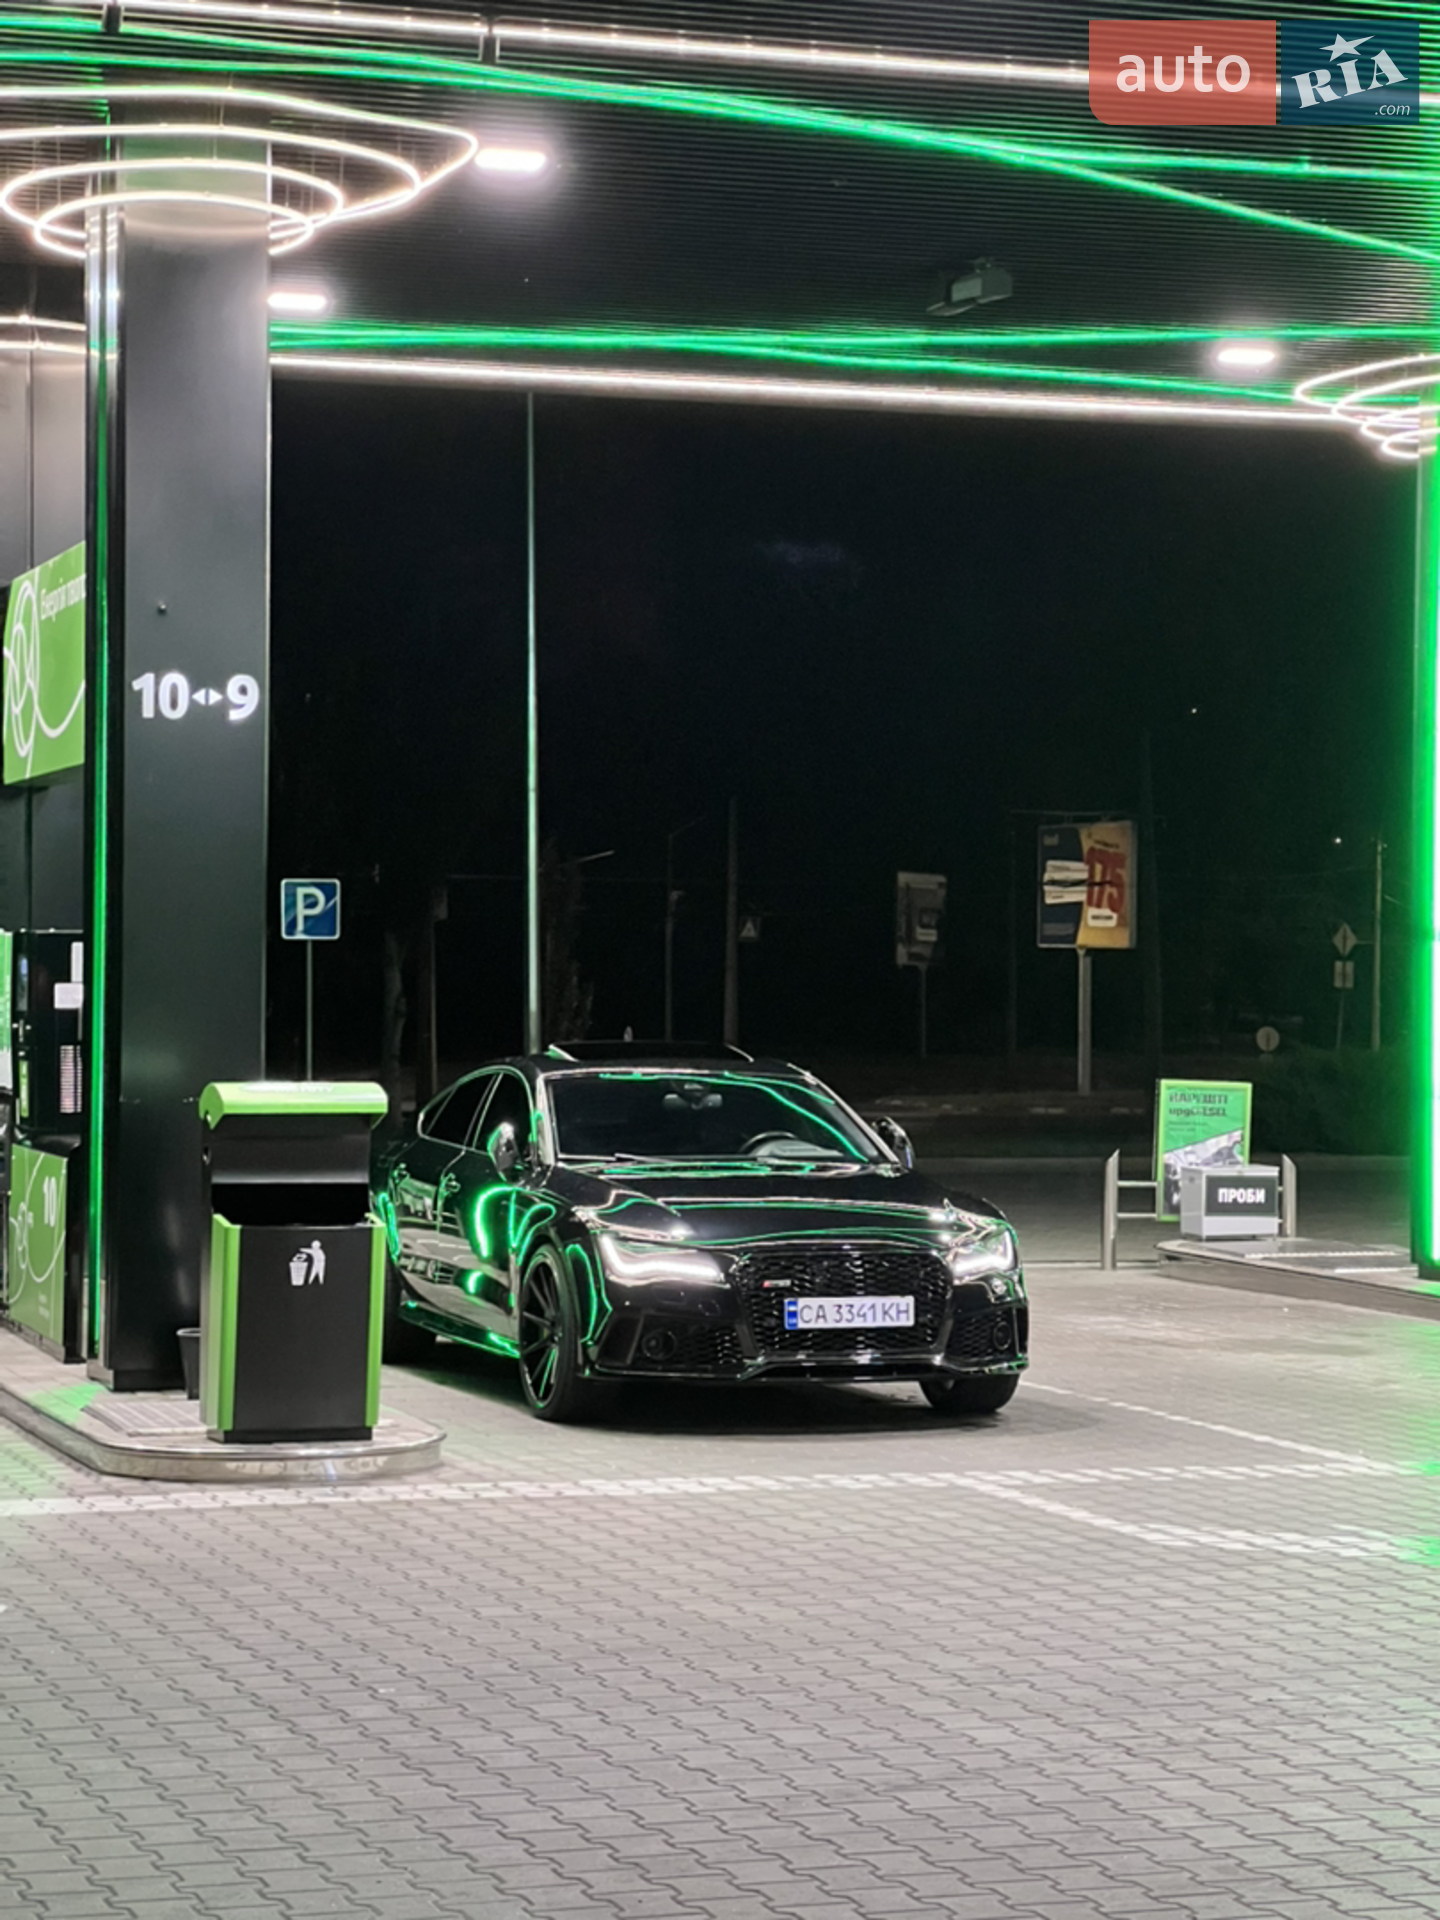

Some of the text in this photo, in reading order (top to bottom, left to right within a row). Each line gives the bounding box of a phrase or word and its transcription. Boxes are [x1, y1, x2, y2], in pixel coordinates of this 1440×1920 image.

[131, 672, 260, 722] 10 9
[295, 886, 326, 934] P
[42, 1176, 58, 1228] 10
[1217, 1187, 1266, 1204] ПРОБИ
[799, 1302, 910, 1324] CA 3341 KH
